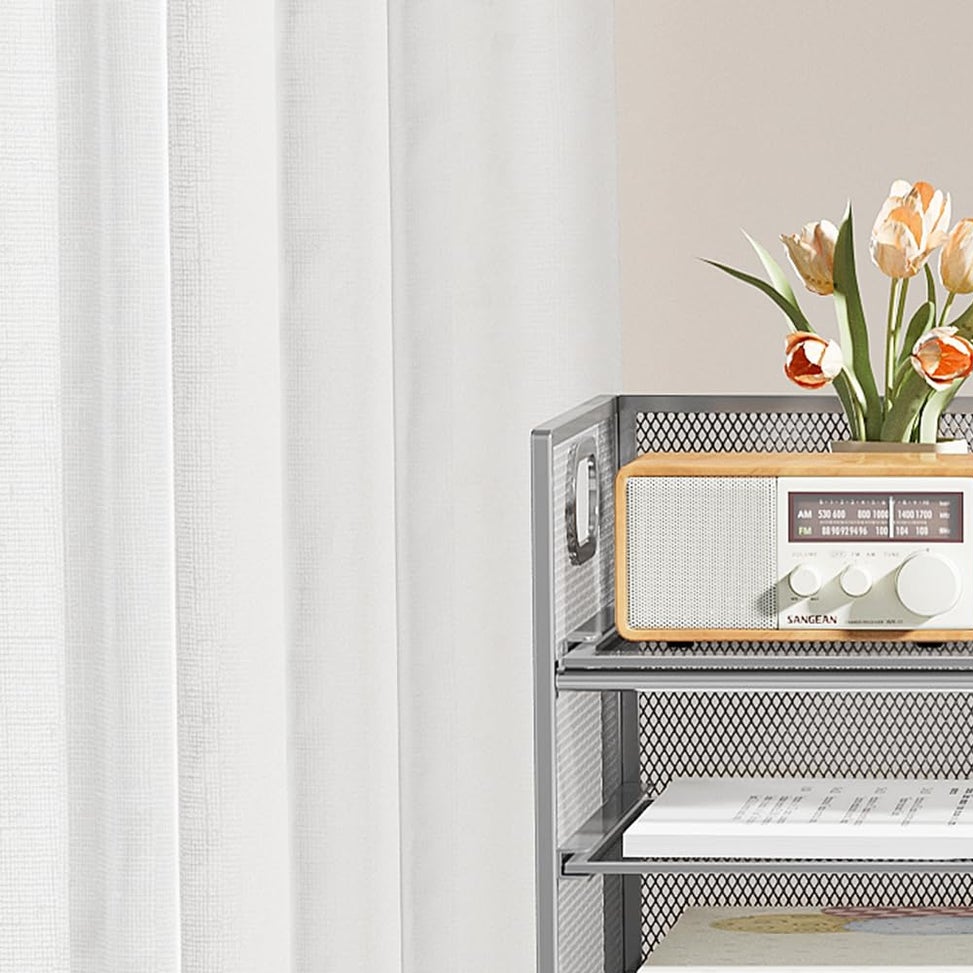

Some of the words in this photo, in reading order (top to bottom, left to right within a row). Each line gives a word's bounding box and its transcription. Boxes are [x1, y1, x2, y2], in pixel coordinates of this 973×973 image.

[797, 509, 813, 519] AM
[798, 526, 813, 536] FM
[787, 615, 838, 625] SANGEAN
